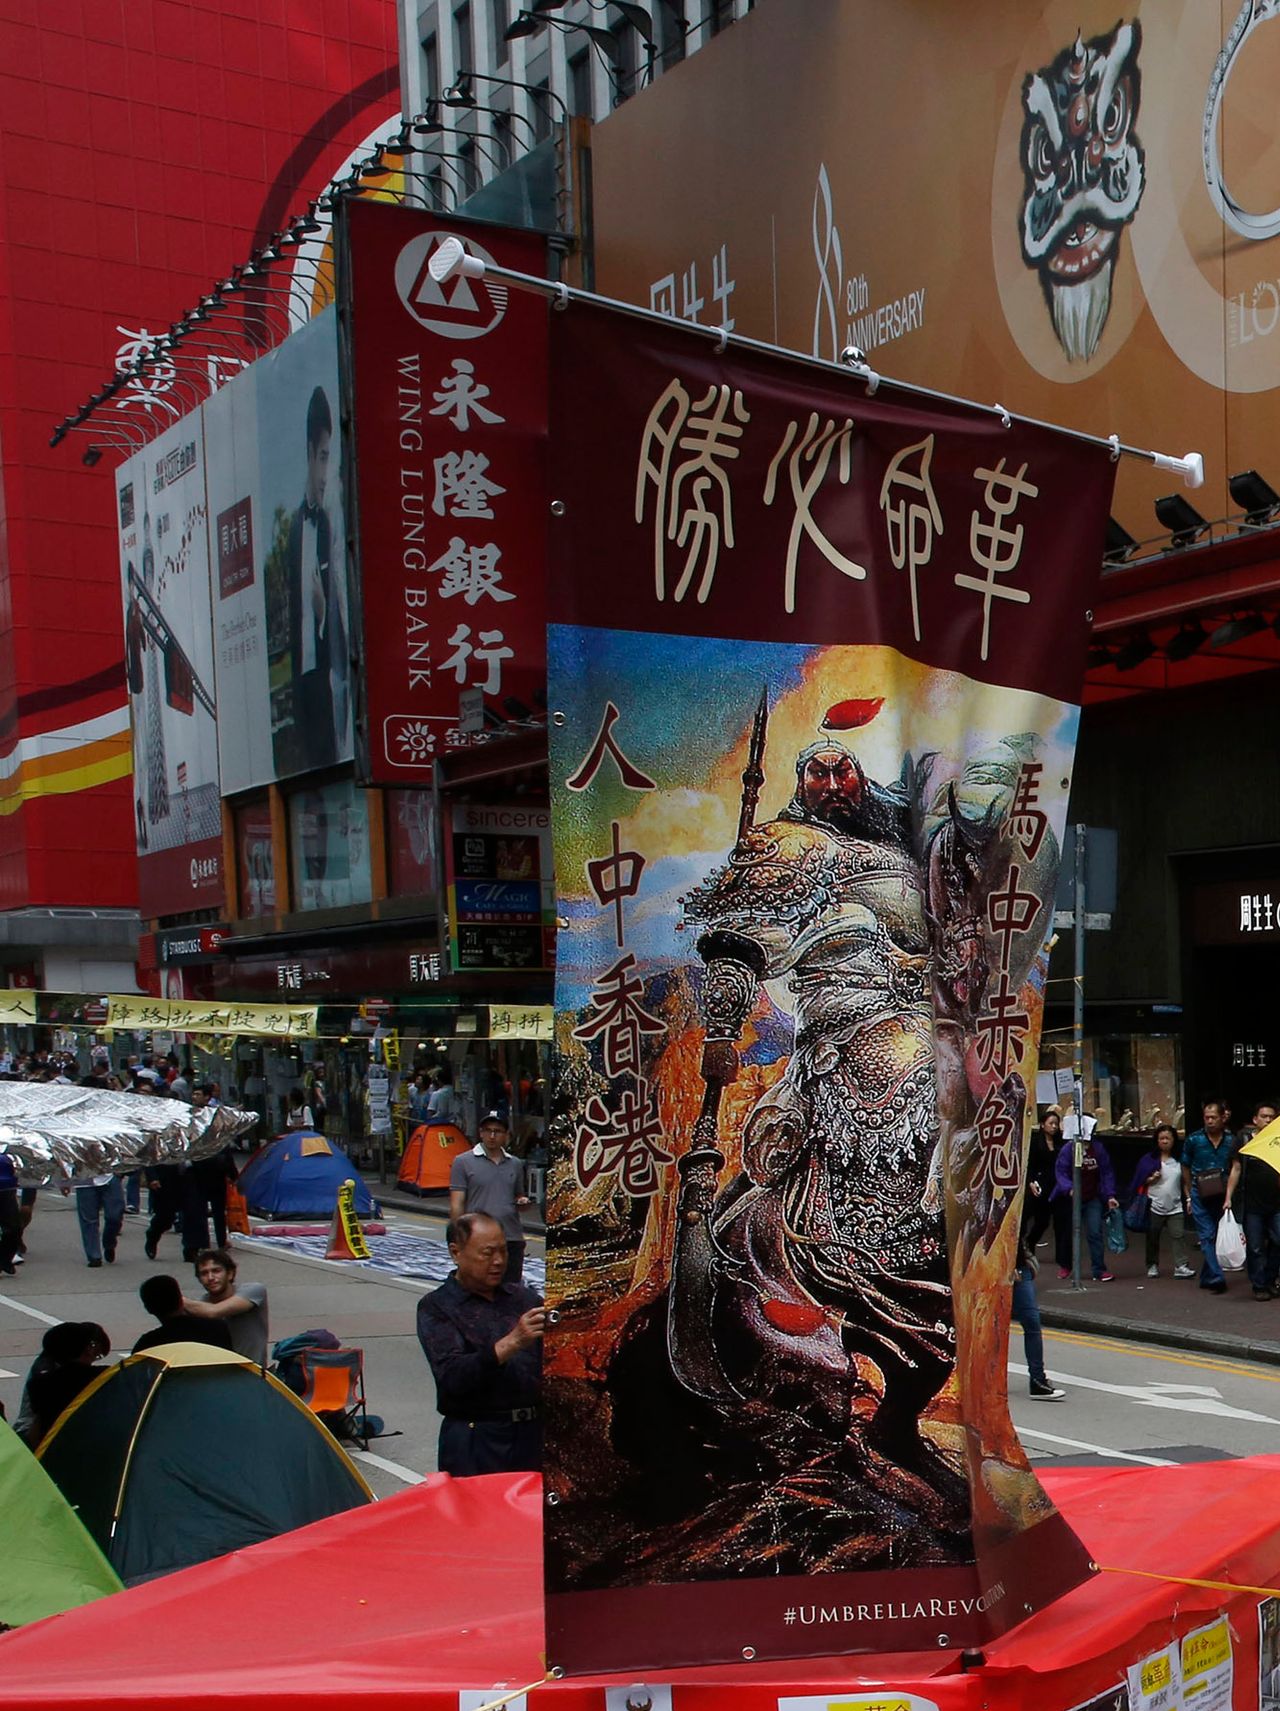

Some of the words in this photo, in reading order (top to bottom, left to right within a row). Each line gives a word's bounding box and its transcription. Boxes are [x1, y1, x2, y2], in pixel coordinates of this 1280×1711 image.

[398, 354, 424, 459] WING
[400, 473, 427, 572] LUNG
[430, 358, 517, 696] 永隆銀行
[404, 586, 432, 690] BANK
[565, 700, 675, 1199] 人中香港
